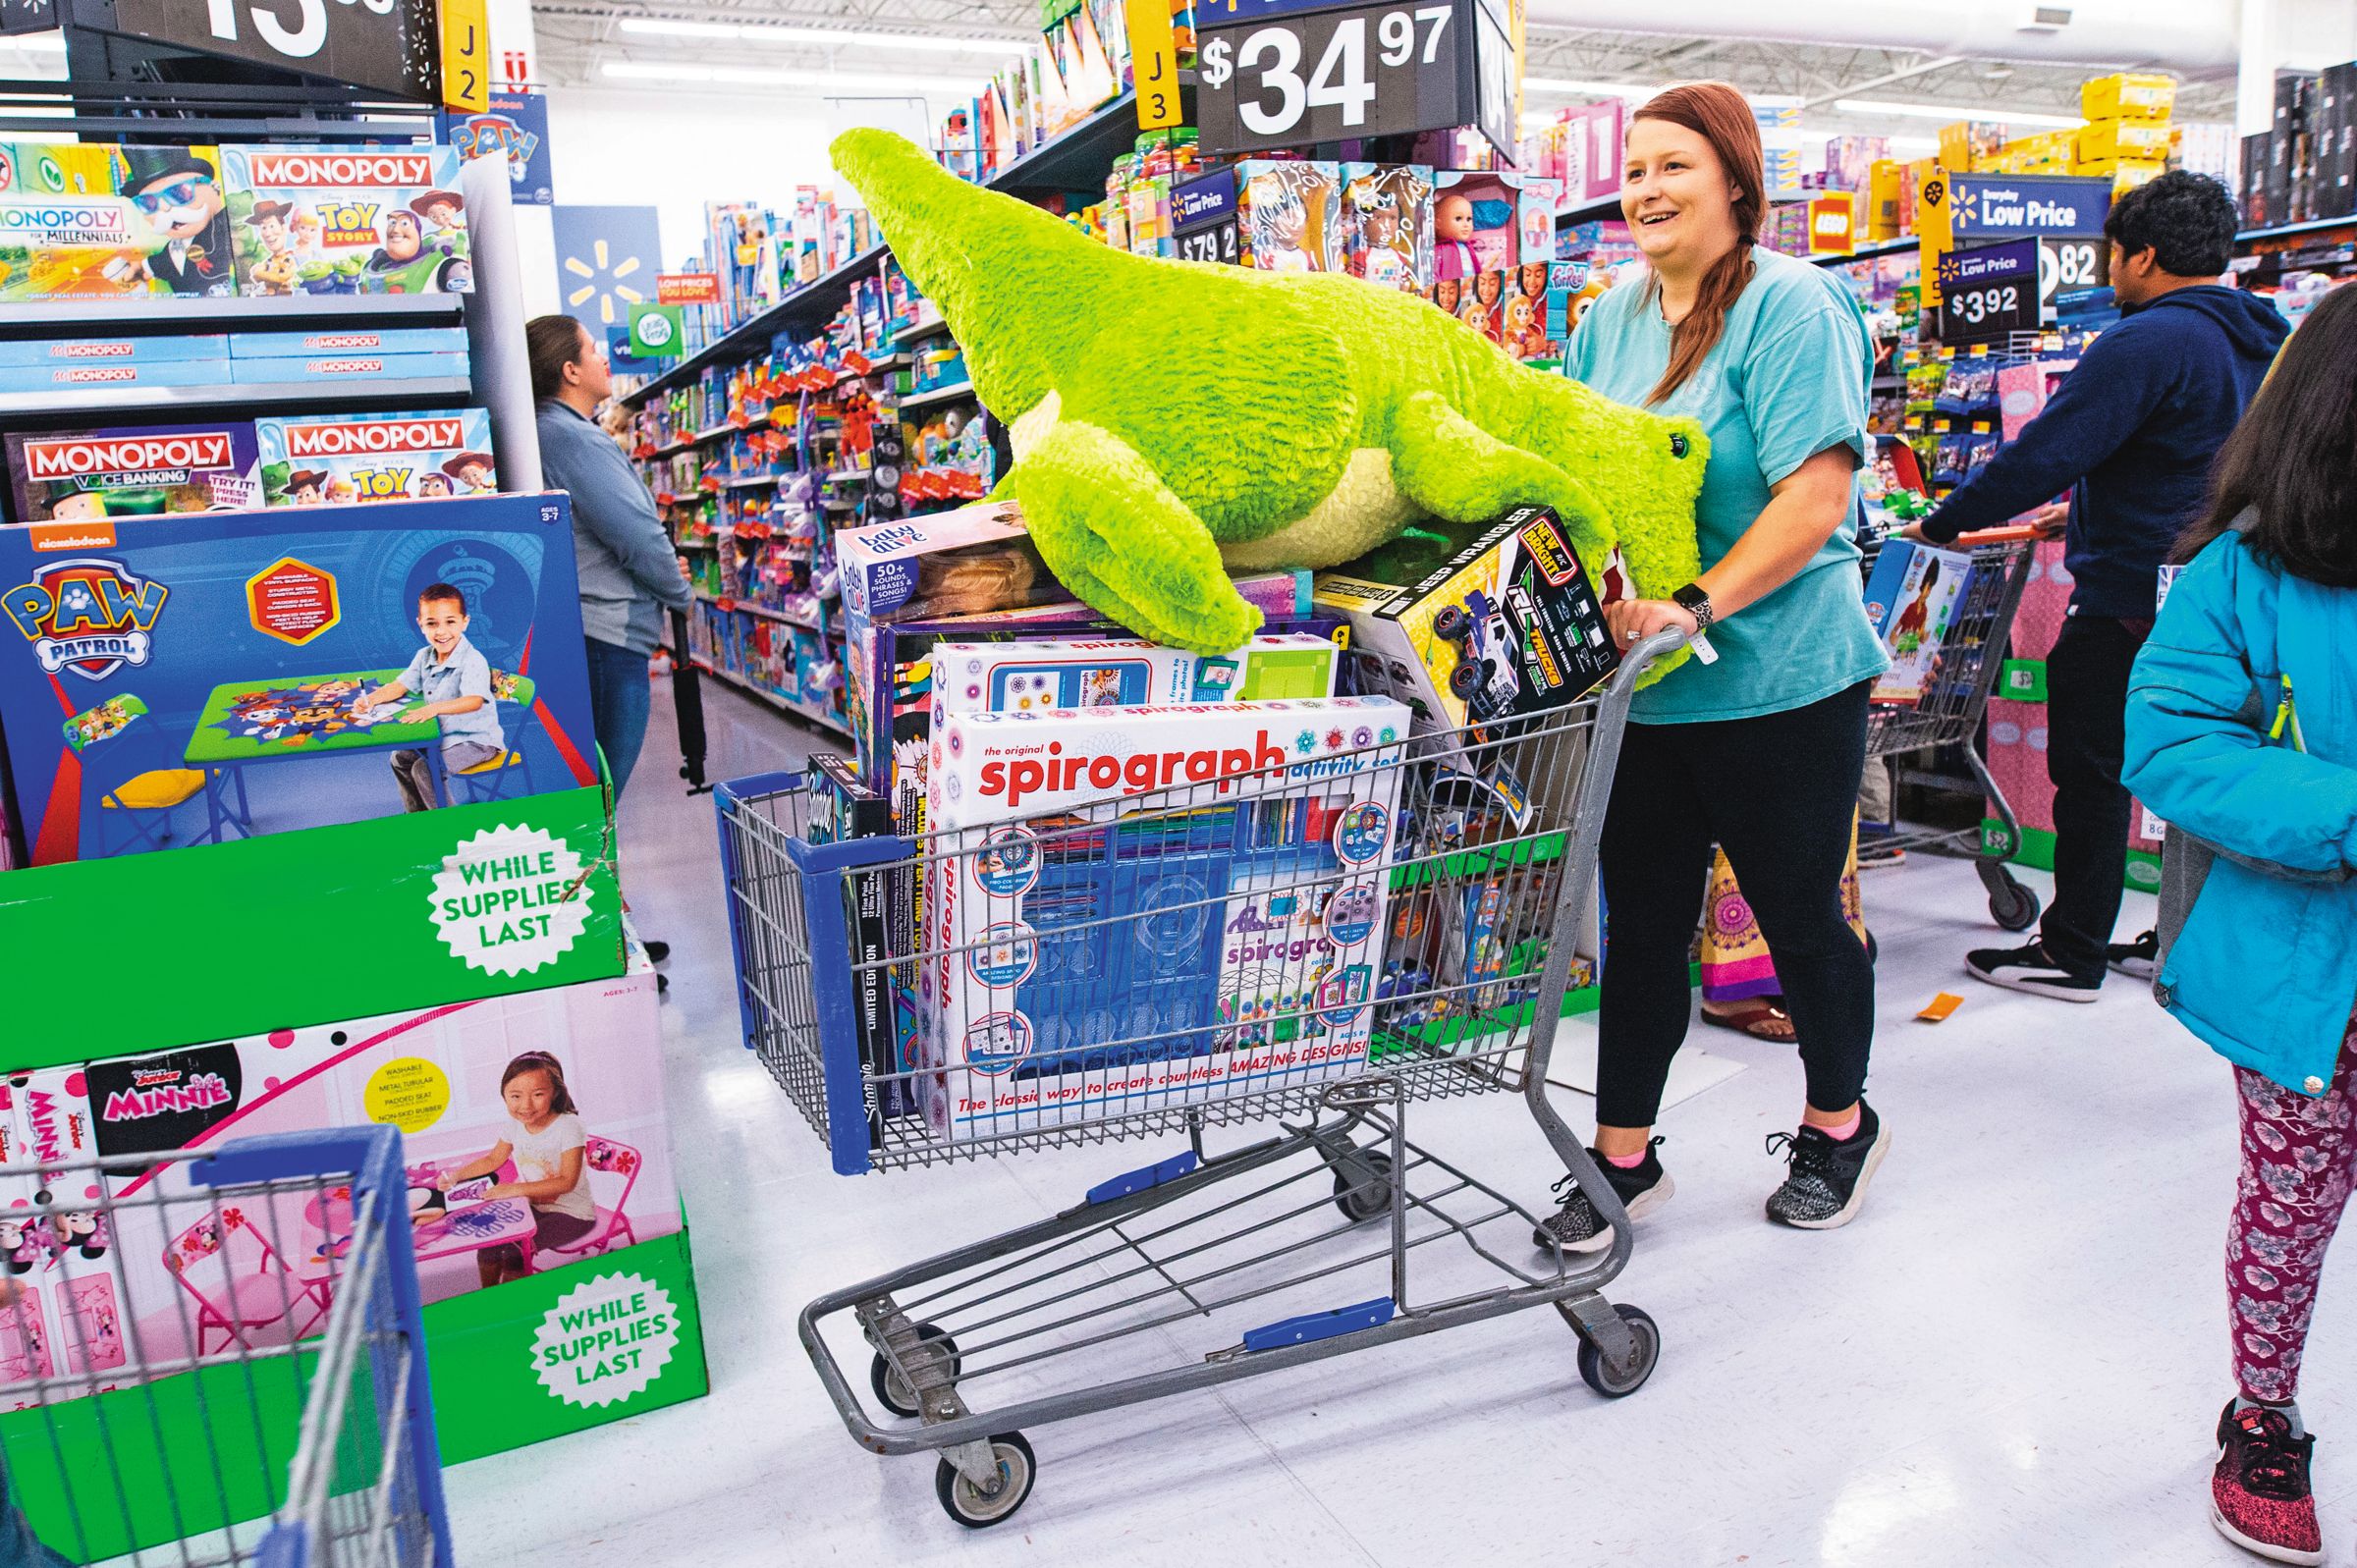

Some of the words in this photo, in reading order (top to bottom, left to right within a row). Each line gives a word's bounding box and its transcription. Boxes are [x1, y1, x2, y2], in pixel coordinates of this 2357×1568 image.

[461, 26, 474, 56] J
[1150, 51, 1162, 81] J
[461, 70, 475, 100] 2
[1152, 93, 1166, 120] 3
[257, 158, 427, 184] MONOPOLY
[1184, 200, 1202, 215] Low
[1201, 192, 1223, 210] Price
[1982, 200, 2025, 226] Low
[2026, 200, 2077, 227] Price
[326, 232, 374, 242] STORY
[1961, 262, 1986, 276] Low
[1987, 257, 2018, 272] Price
[681, 278, 714, 287] PRICES
[68, 346, 132, 356] MONOPOLY
[319, 336, 379, 347] MONOPOLY
[71, 369, 136, 381] MONOPOLY
[322, 360, 382, 372] MONOPOLY
[295, 423, 460, 455] MONOPOLY
[36, 438, 225, 475] MONOPOLY
[81, 474, 122, 488] VOICE
[124, 470, 187, 485] BANKING
[210, 477, 237, 488] TRY
[216, 488, 248, 499] PRESS
[542, 512, 559, 522] 3-7
[858, 525, 915, 546] baby
[1533, 521, 1561, 551] NEW
[1414, 567, 1453, 593] JEEP
[1449, 508, 1538, 566] WRANGLER
[1523, 529, 1561, 576] BRIGHT
[1556, 553, 1567, 567] R/C
[877, 564, 904, 577] 50+
[871, 581, 904, 593] PHRASES
[878, 587, 907, 599] SONGS!
[1, 578, 169, 641] PAW
[50, 638, 137, 661] PATROL
[1541, 608, 1556, 633] FUNCTION
[1560, 651, 1572, 674] CONTROL
[1530, 628, 1562, 686] TRUCKS
[1124, 702, 1262, 717] spirograph
[985, 746, 1001, 756] the
[1005, 744, 1045, 757] original
[978, 730, 1286, 806] spirograph
[459, 851, 556, 887] WHILE
[443, 879, 579, 921] SUPPLIES
[479, 914, 551, 947] LAST
[865, 945, 876, 987] EDIION
[865, 989, 876, 1030] LIMITED
[385, 1064, 422, 1075] WASHABLE
[404, 1077, 434, 1087] TUBULAR
[104, 1074, 232, 1121] MINNIE
[384, 1095, 414, 1106] PADDED
[959, 1099, 987, 1112] The
[1047, 1088, 1081, 1102] way
[1087, 1083, 1102, 1095] to
[1107, 1075, 1154, 1092] create
[559, 1292, 646, 1333] WHILE
[543, 1314, 668, 1367] SUPPLIES
[576, 1348, 641, 1385] LAST
